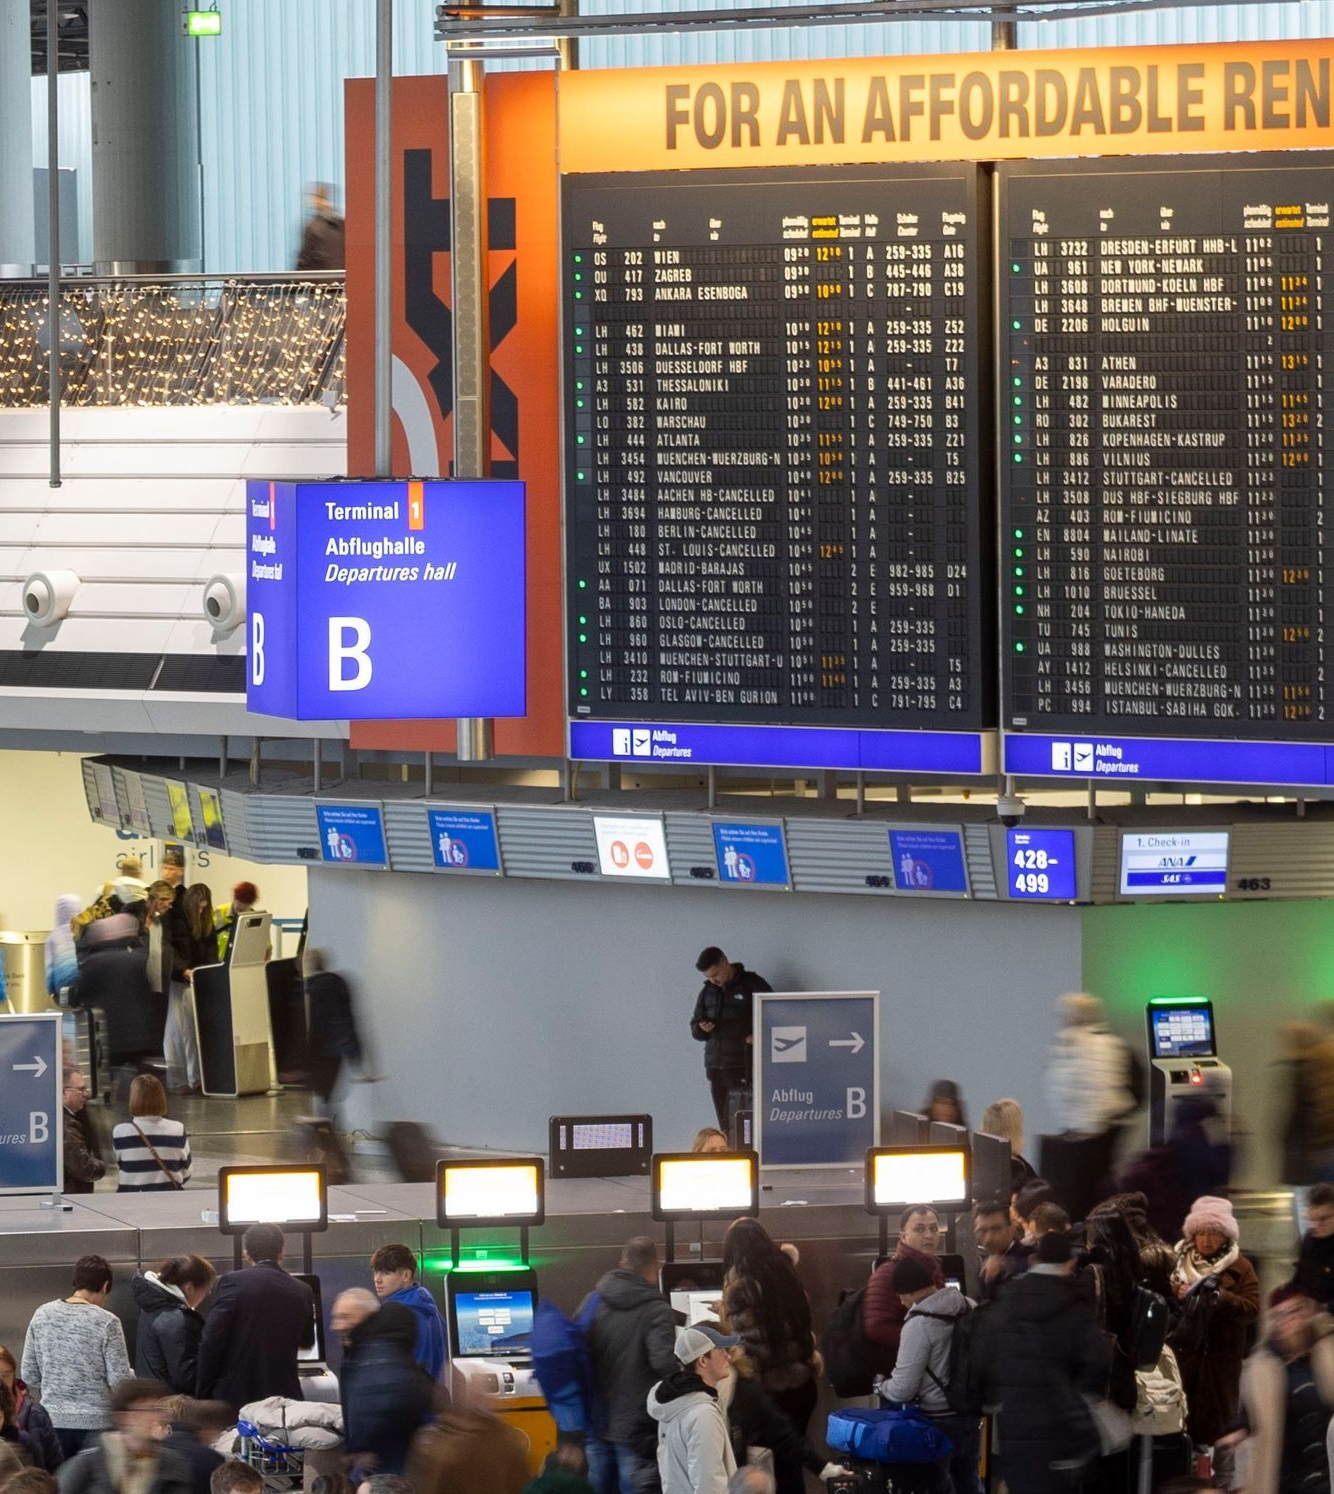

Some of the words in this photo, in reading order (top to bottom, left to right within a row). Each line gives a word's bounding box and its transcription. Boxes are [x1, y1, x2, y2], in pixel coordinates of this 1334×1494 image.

[665, 81, 759, 150] FOR
[777, 77, 846, 146] AN
[861, 62, 1205, 143] AFFORDABLE
[594, 252, 607, 265] OS
[624, 252, 643, 265] 202
[655, 251, 679, 264] WIEN
[886, 246, 931, 260] 259-335
[944, 245, 964, 259] A16
[594, 270, 608, 284] OU
[625, 270, 643, 283] 417
[655, 269, 692, 283] ZAGREB
[886, 264, 932, 278] 445-446
[944, 263, 964, 277] A38
[1034, 262, 1048, 275] UA
[1068, 261, 1088, 274] 961
[1101, 259, 1121, 274] NEW
[1128, 259, 1204, 273] YORK-NEWARK
[655, 287, 692, 301] ANKARA
[698, 287, 748, 300] ESENBOGA
[1102, 316, 1150, 330] HOLGUIN
[656, 341, 723, 355] DALLAS-FORT
[729, 341, 761, 355] WORTH
[656, 378, 729, 392] THESSALONIKI
[1102, 375, 1157, 389] VARADERO
[656, 416, 706, 429] WARSCHAU
[1103, 432, 1225, 446] KOPENHAGEN-KASTRUP
[657, 470, 712, 484] VANCOUVER
[1103, 471, 1232, 485] STUTTGART-CANCELLED
[325, 502, 399, 520] Terminal
[411, 502, 419, 519] 1
[658, 507, 762, 521] HAMBURG-CANCELLED
[325, 537, 425, 559] Abflughalle
[325, 564, 418, 585] Departures
[423, 562, 456, 581] hall
[658, 561, 745, 576] MADRID-BARAJAS
[1104, 567, 1165, 581] GOETEBORG
[1104, 605, 1185, 620] TOKIO-HANEDA
[660, 634, 764, 648] GLASGOW-CANCELLED
[253, 612, 265, 686] B
[328, 617, 373, 692] B
[1104, 643, 1220, 659] WASHINGTON-DULLES
[661, 689, 678, 703] TEL
[685, 689, 735, 704] AVIV-BEN
[740, 689, 778, 704] GURION
[653, 730, 676, 744] Abflug
[653, 746, 692, 759] Departures
[1096, 744, 1122, 759] Abflug
[1096, 760, 1139, 774] Departures
[1147, 836, 1190, 847] Check-in
[1014, 850, 1058, 869] 428-
[1159, 857, 1185, 867] ANA
[1015, 874, 1049, 893] 499
[1238, 878, 1271, 891] 463
[772, 1089, 813, 1103] Abflug
[847, 1087, 866, 1119] B
[770, 1108, 843, 1123] Departures
[30, 1112, 49, 1143] B
